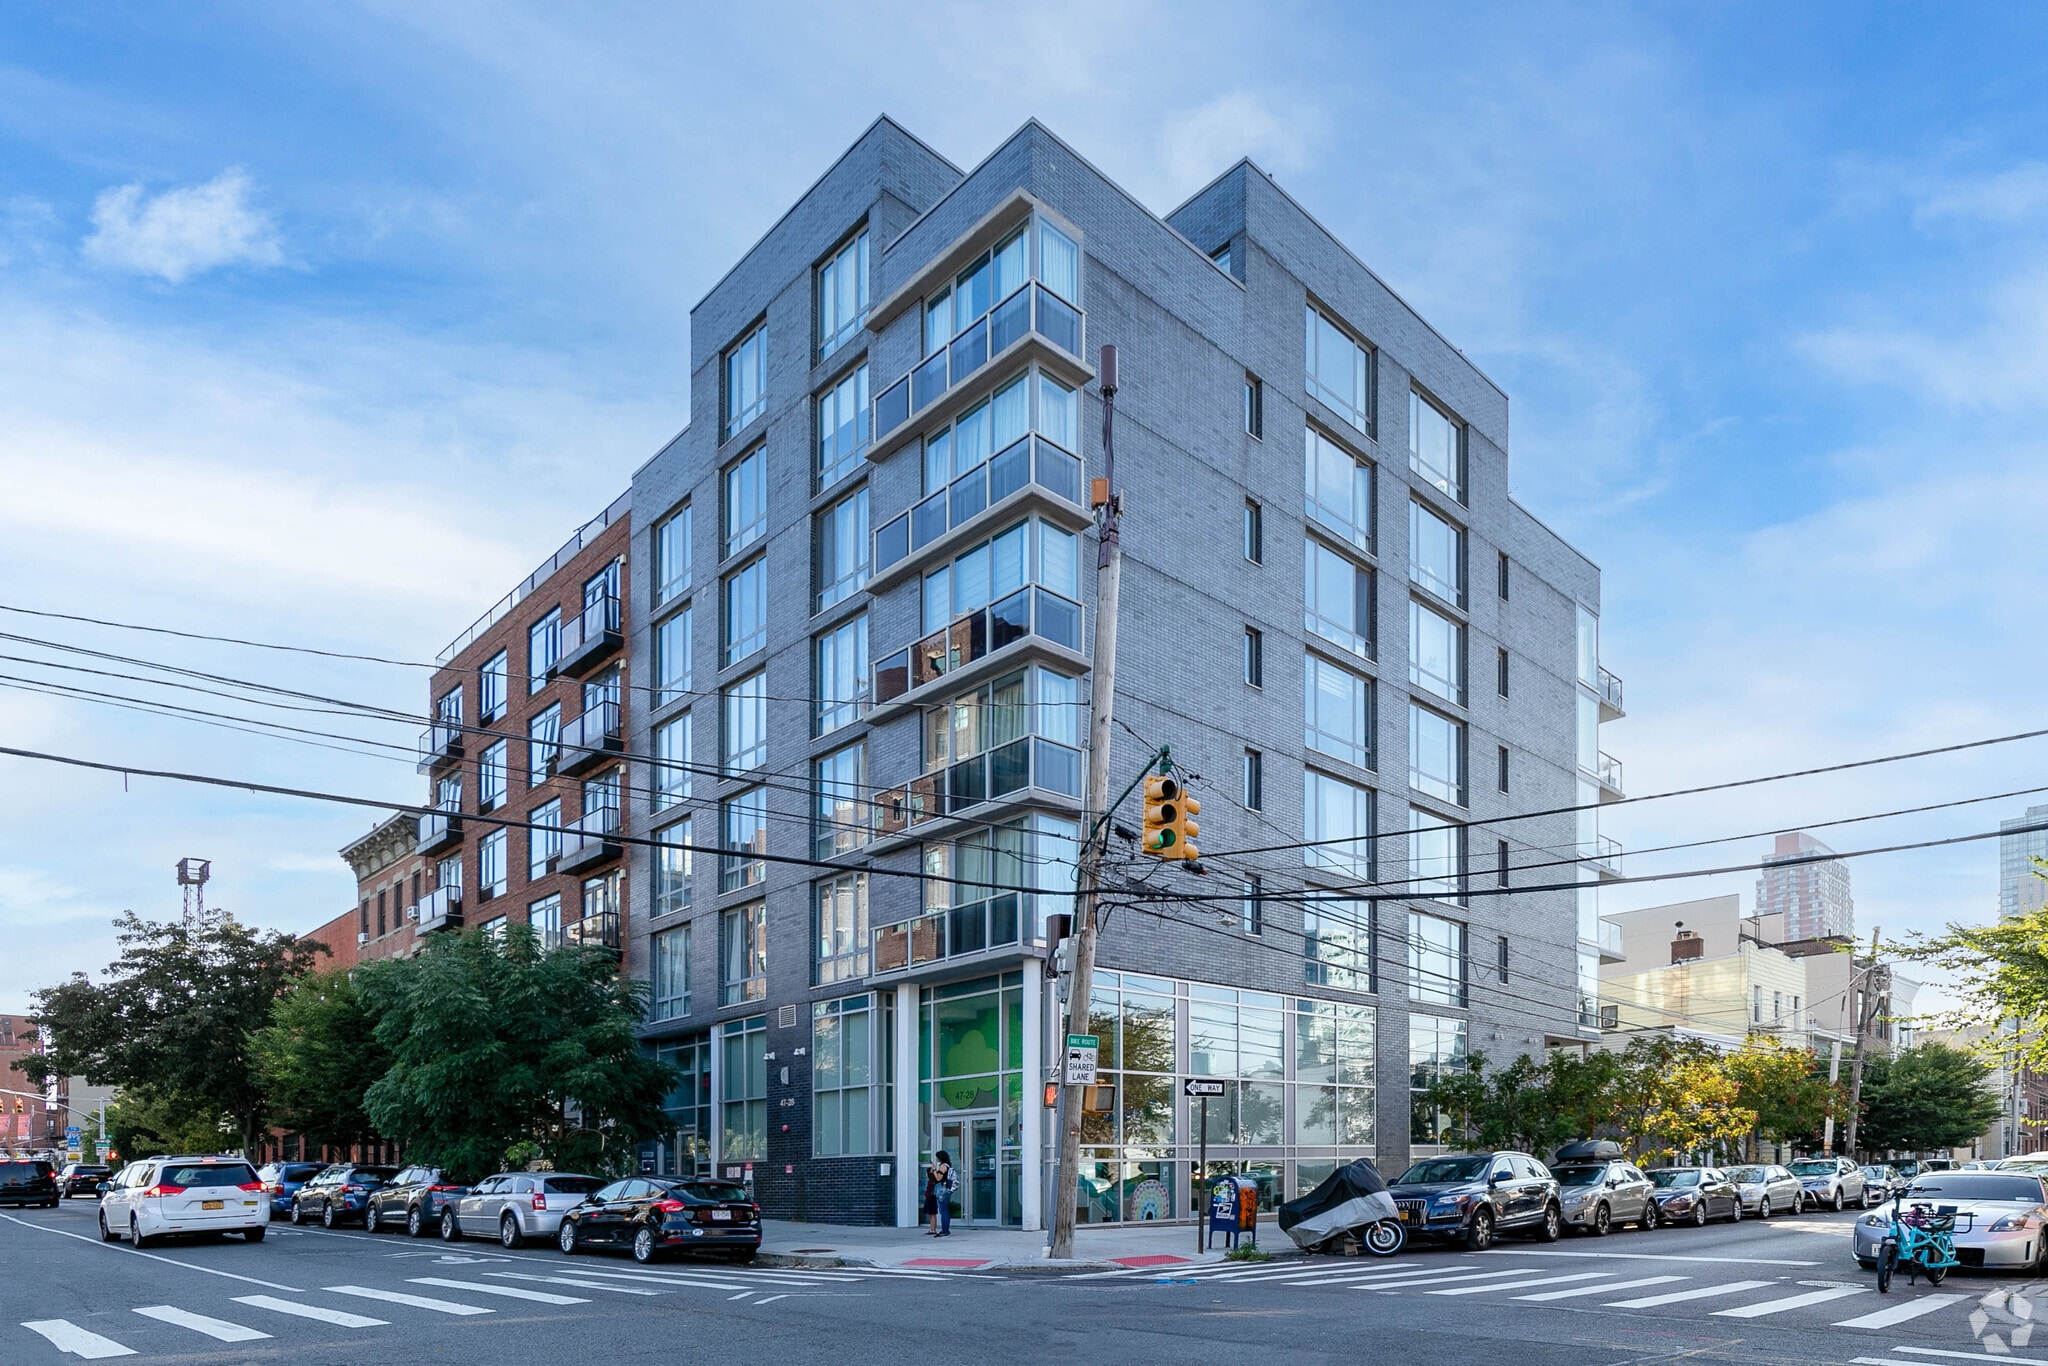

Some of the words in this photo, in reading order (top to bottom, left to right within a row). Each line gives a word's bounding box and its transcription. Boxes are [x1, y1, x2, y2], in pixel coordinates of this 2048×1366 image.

[1069, 1063, 1094, 1072] SHARED
[1072, 1073, 1090, 1081] LANE
[1190, 1083, 1203, 1092] ONE
[1207, 1084, 1221, 1092] WAY
[955, 1090, 974, 1100] 47-28
[780, 1098, 795, 1107] 47-28
